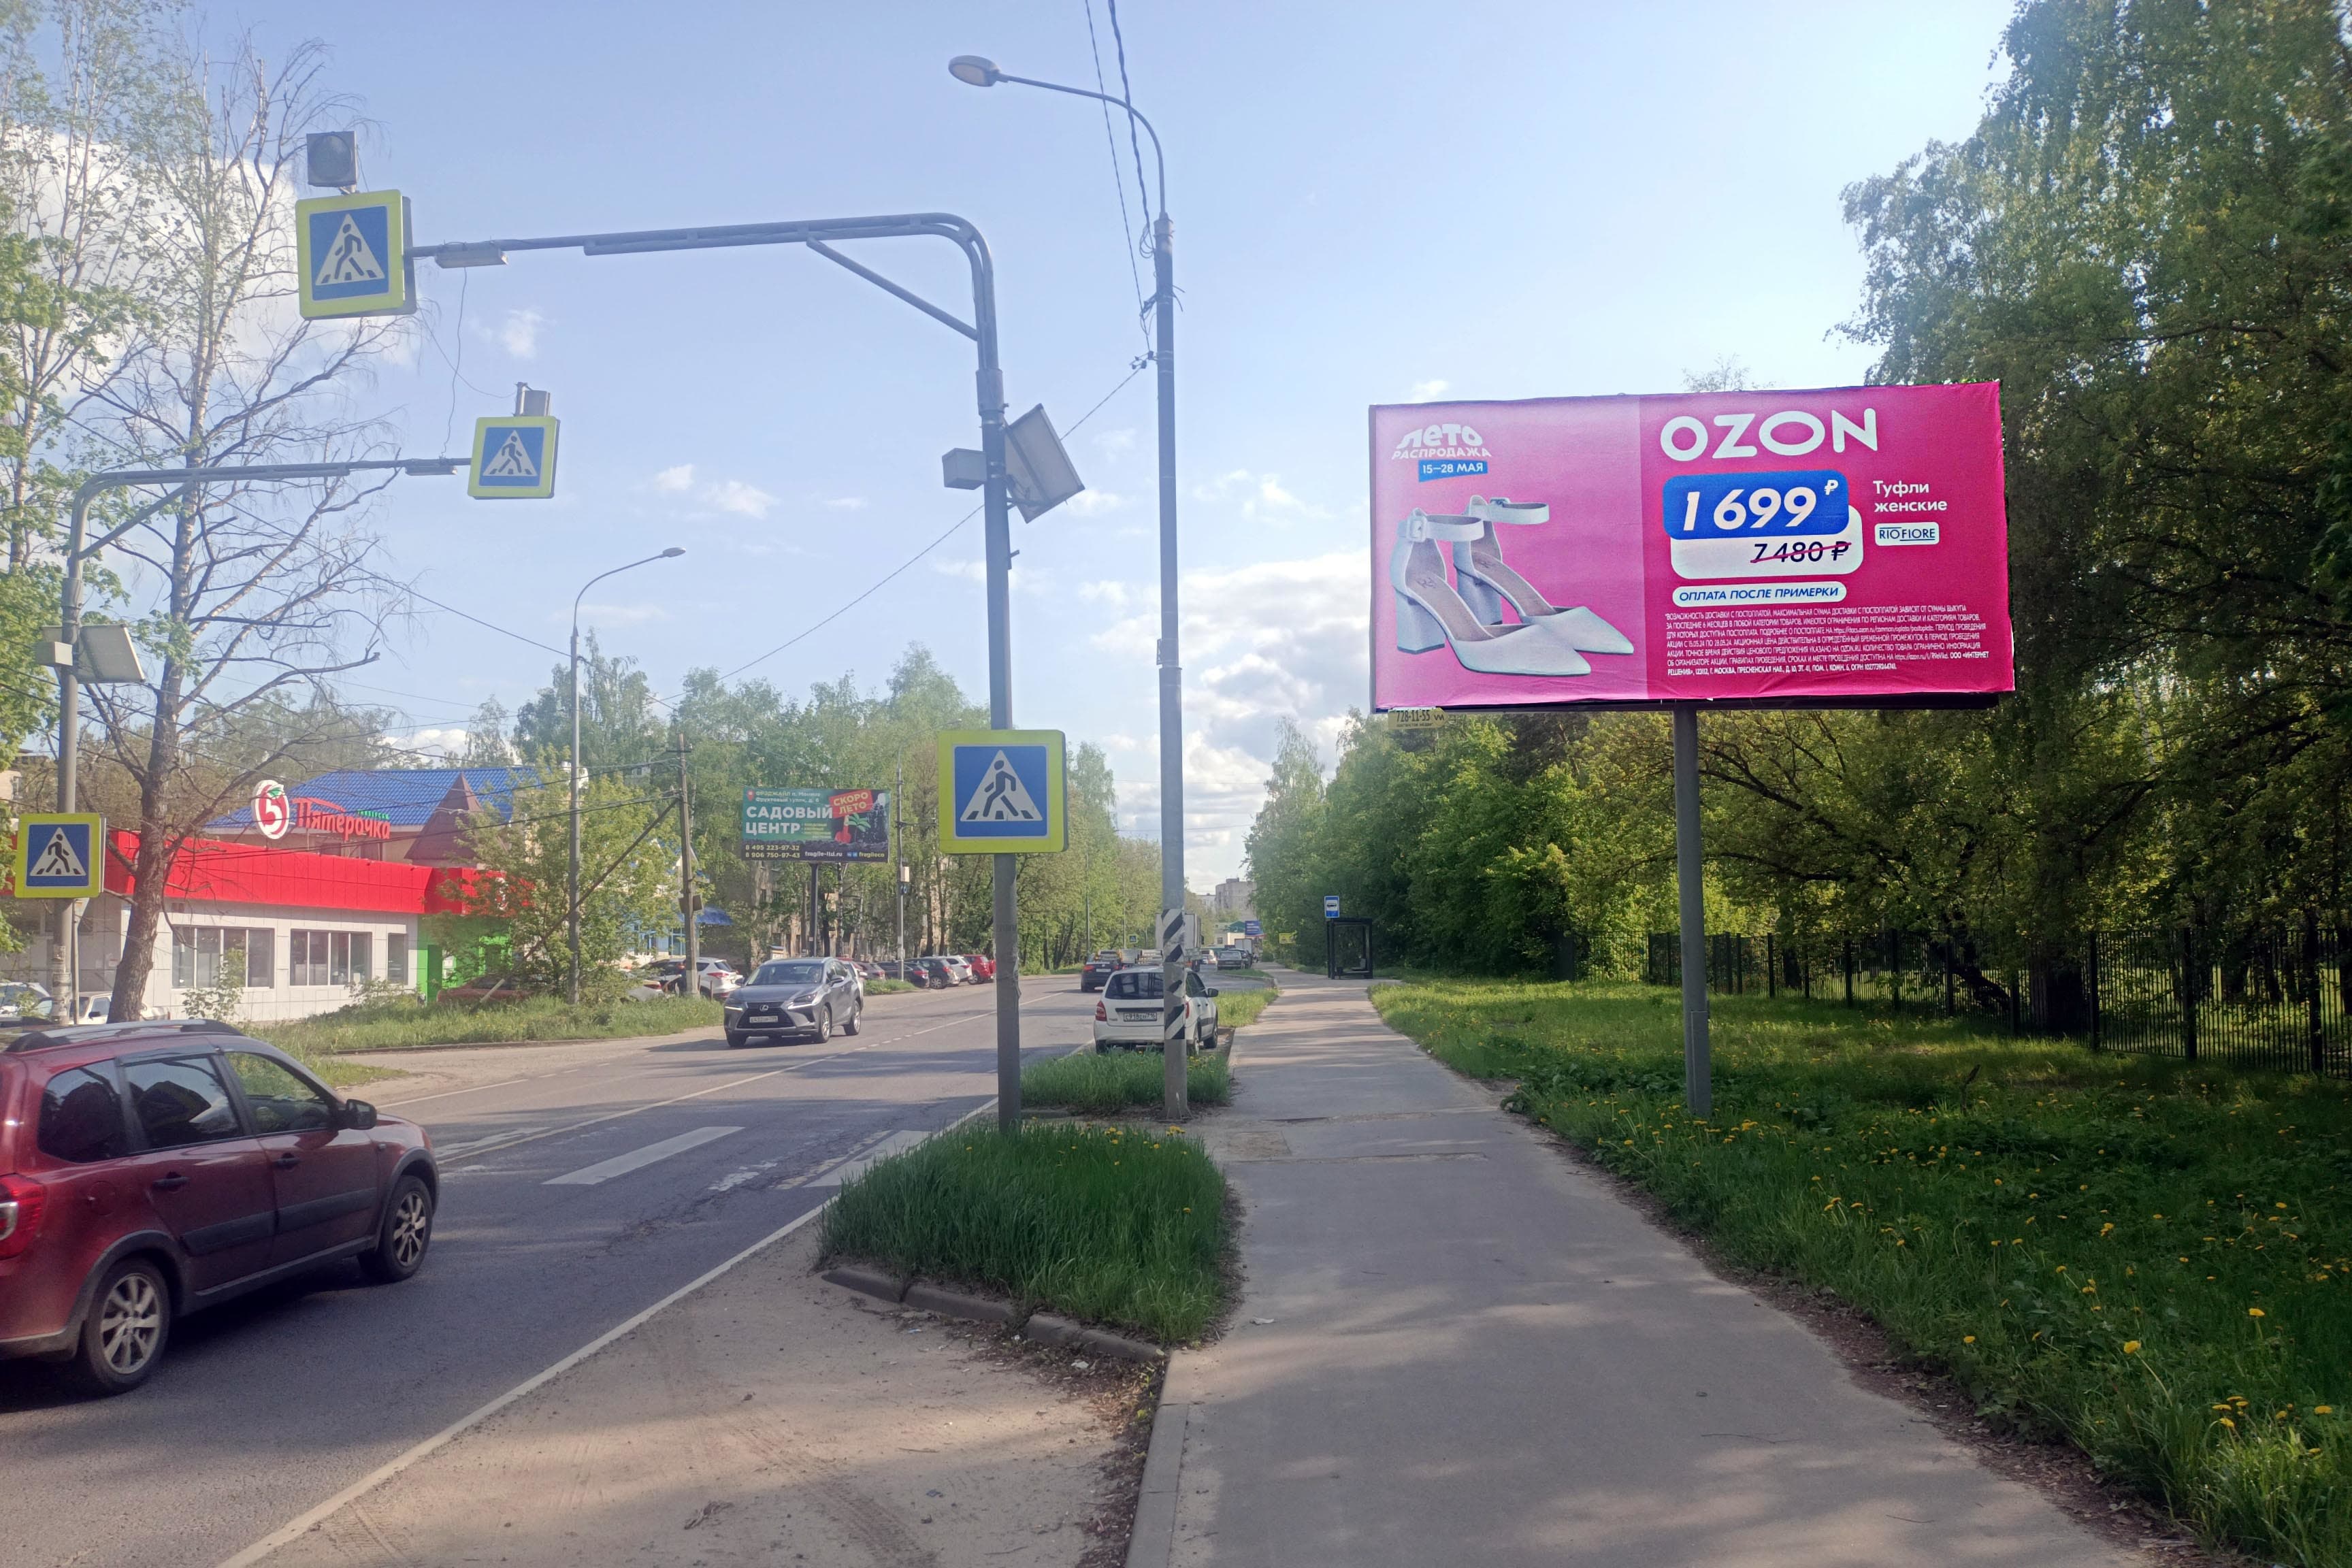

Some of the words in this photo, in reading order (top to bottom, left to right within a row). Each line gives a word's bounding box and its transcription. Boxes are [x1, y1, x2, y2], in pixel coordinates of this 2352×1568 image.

[1660, 408, 1877, 461] OZON
[1392, 447, 1492, 459] РАСПРОДАЖА
[1457, 462, 1483, 472] МАЯ
[1873, 480, 1929, 497] Туфли
[1874, 499, 1947, 512] женские
[1679, 589, 1727, 602] ОПЛАТА
[1730, 588, 1771, 600] ПОСЛЕ
[1774, 587, 1839, 598] ПРИМЕРКИ
[833, 791, 868, 806] СКОРО
[746, 804, 833, 820] САДОВЫЙ
[839, 802, 866, 815] ЛЕТО
[745, 821, 801, 836] ЦЕНТР
